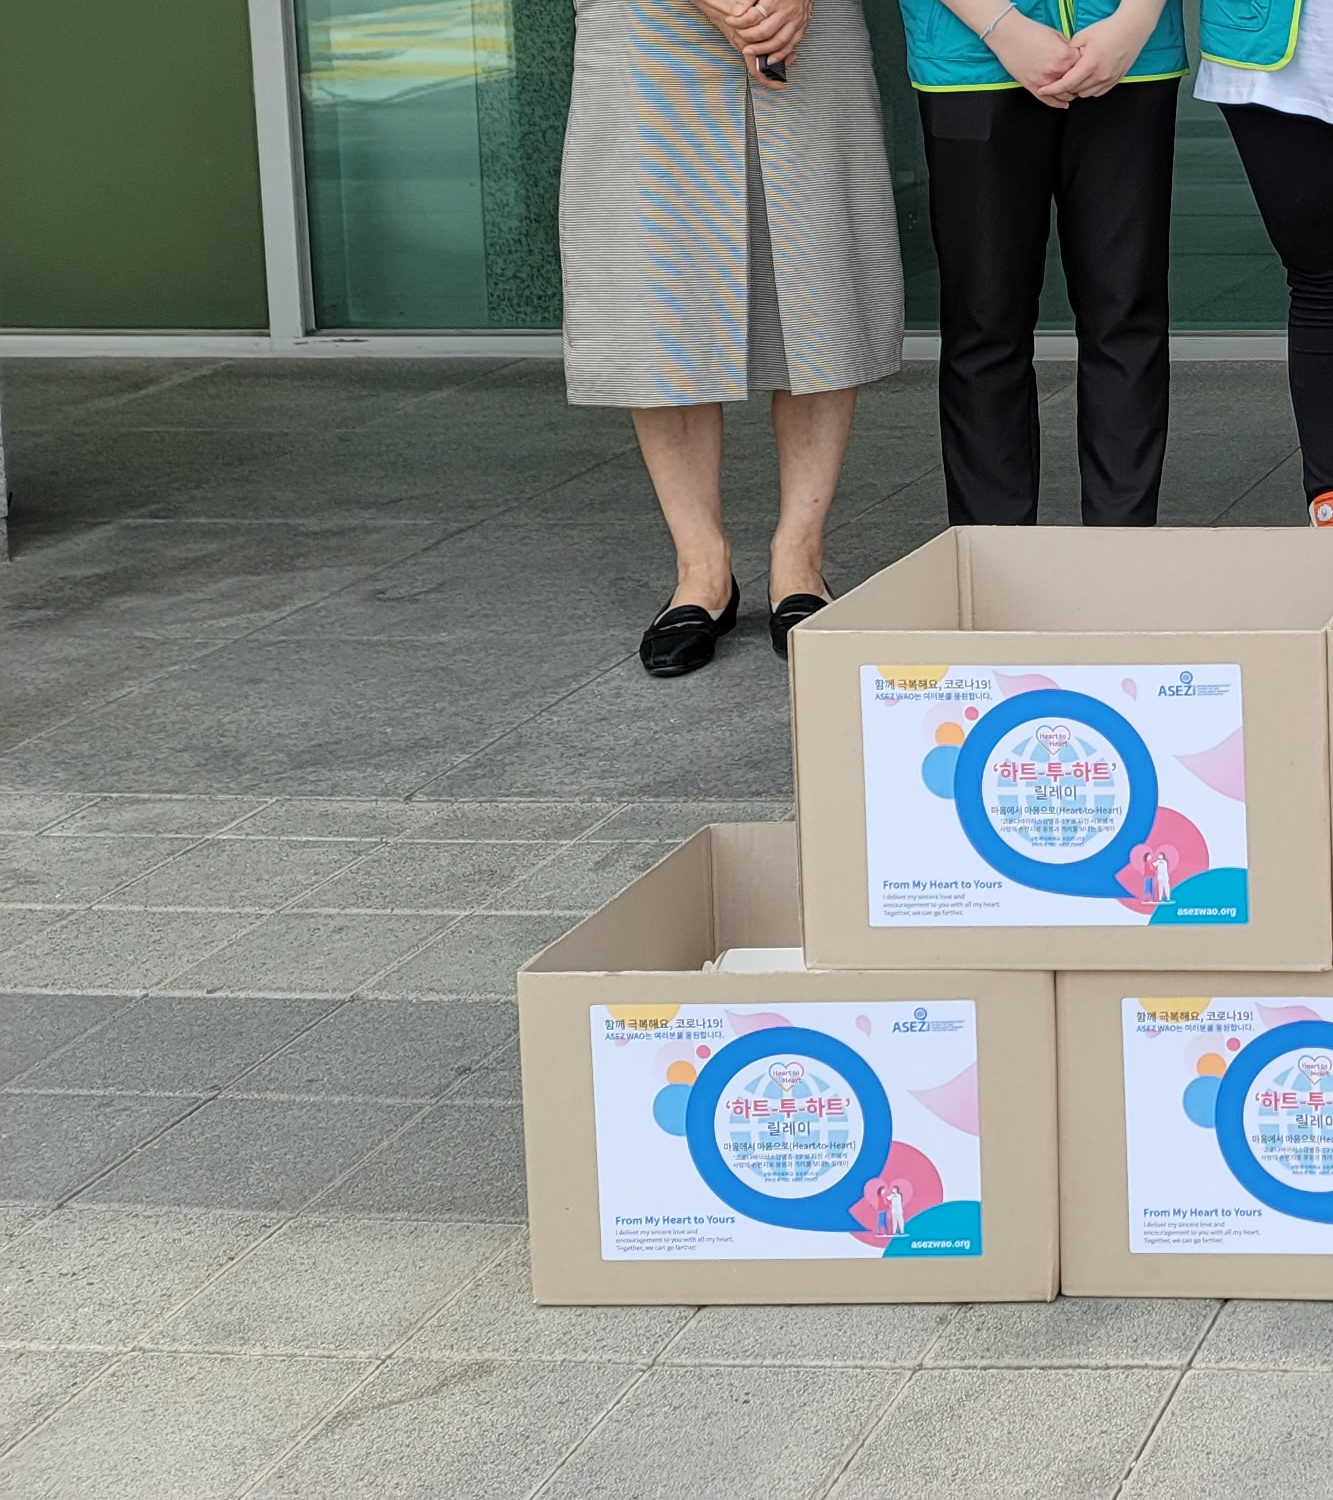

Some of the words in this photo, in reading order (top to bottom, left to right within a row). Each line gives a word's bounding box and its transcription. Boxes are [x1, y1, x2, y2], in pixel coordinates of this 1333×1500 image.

[874, 679, 894, 690] 함께
[944, 678, 991, 690] 코로나19!
[1034, 785, 1076, 800] 릴레이
[883, 880, 910, 889] From
[912, 880, 927, 891] My
[929, 879, 959, 889] Heart
[961, 880, 972, 888] to
[973, 879, 1002, 888] Yours
[1176, 907, 1236, 918] asezwao.org
[1136, 1009, 1157, 1020] 함께
[1205, 1010, 1253, 1022] 코로나19!
[605, 1018, 625, 1030] 함께
[675, 1017, 723, 1029] 코로나19!
[767, 1121, 810, 1136] 릴레이
[1143, 1207, 1170, 1216] From
[1172, 1207, 1187, 1218] My
[1190, 1207, 1219, 1216] Heart
[1221, 1208, 1231, 1216] to
[1233, 1207, 1262, 1216] Yours
[615, 1216, 642, 1225] From
[644, 1216, 660, 1227] My
[662, 1215, 691, 1224] Heart
[693, 1215, 704, 1224] to
[706, 1214, 735, 1224] Yours
[910, 1239, 970, 1250] asezwao.org
